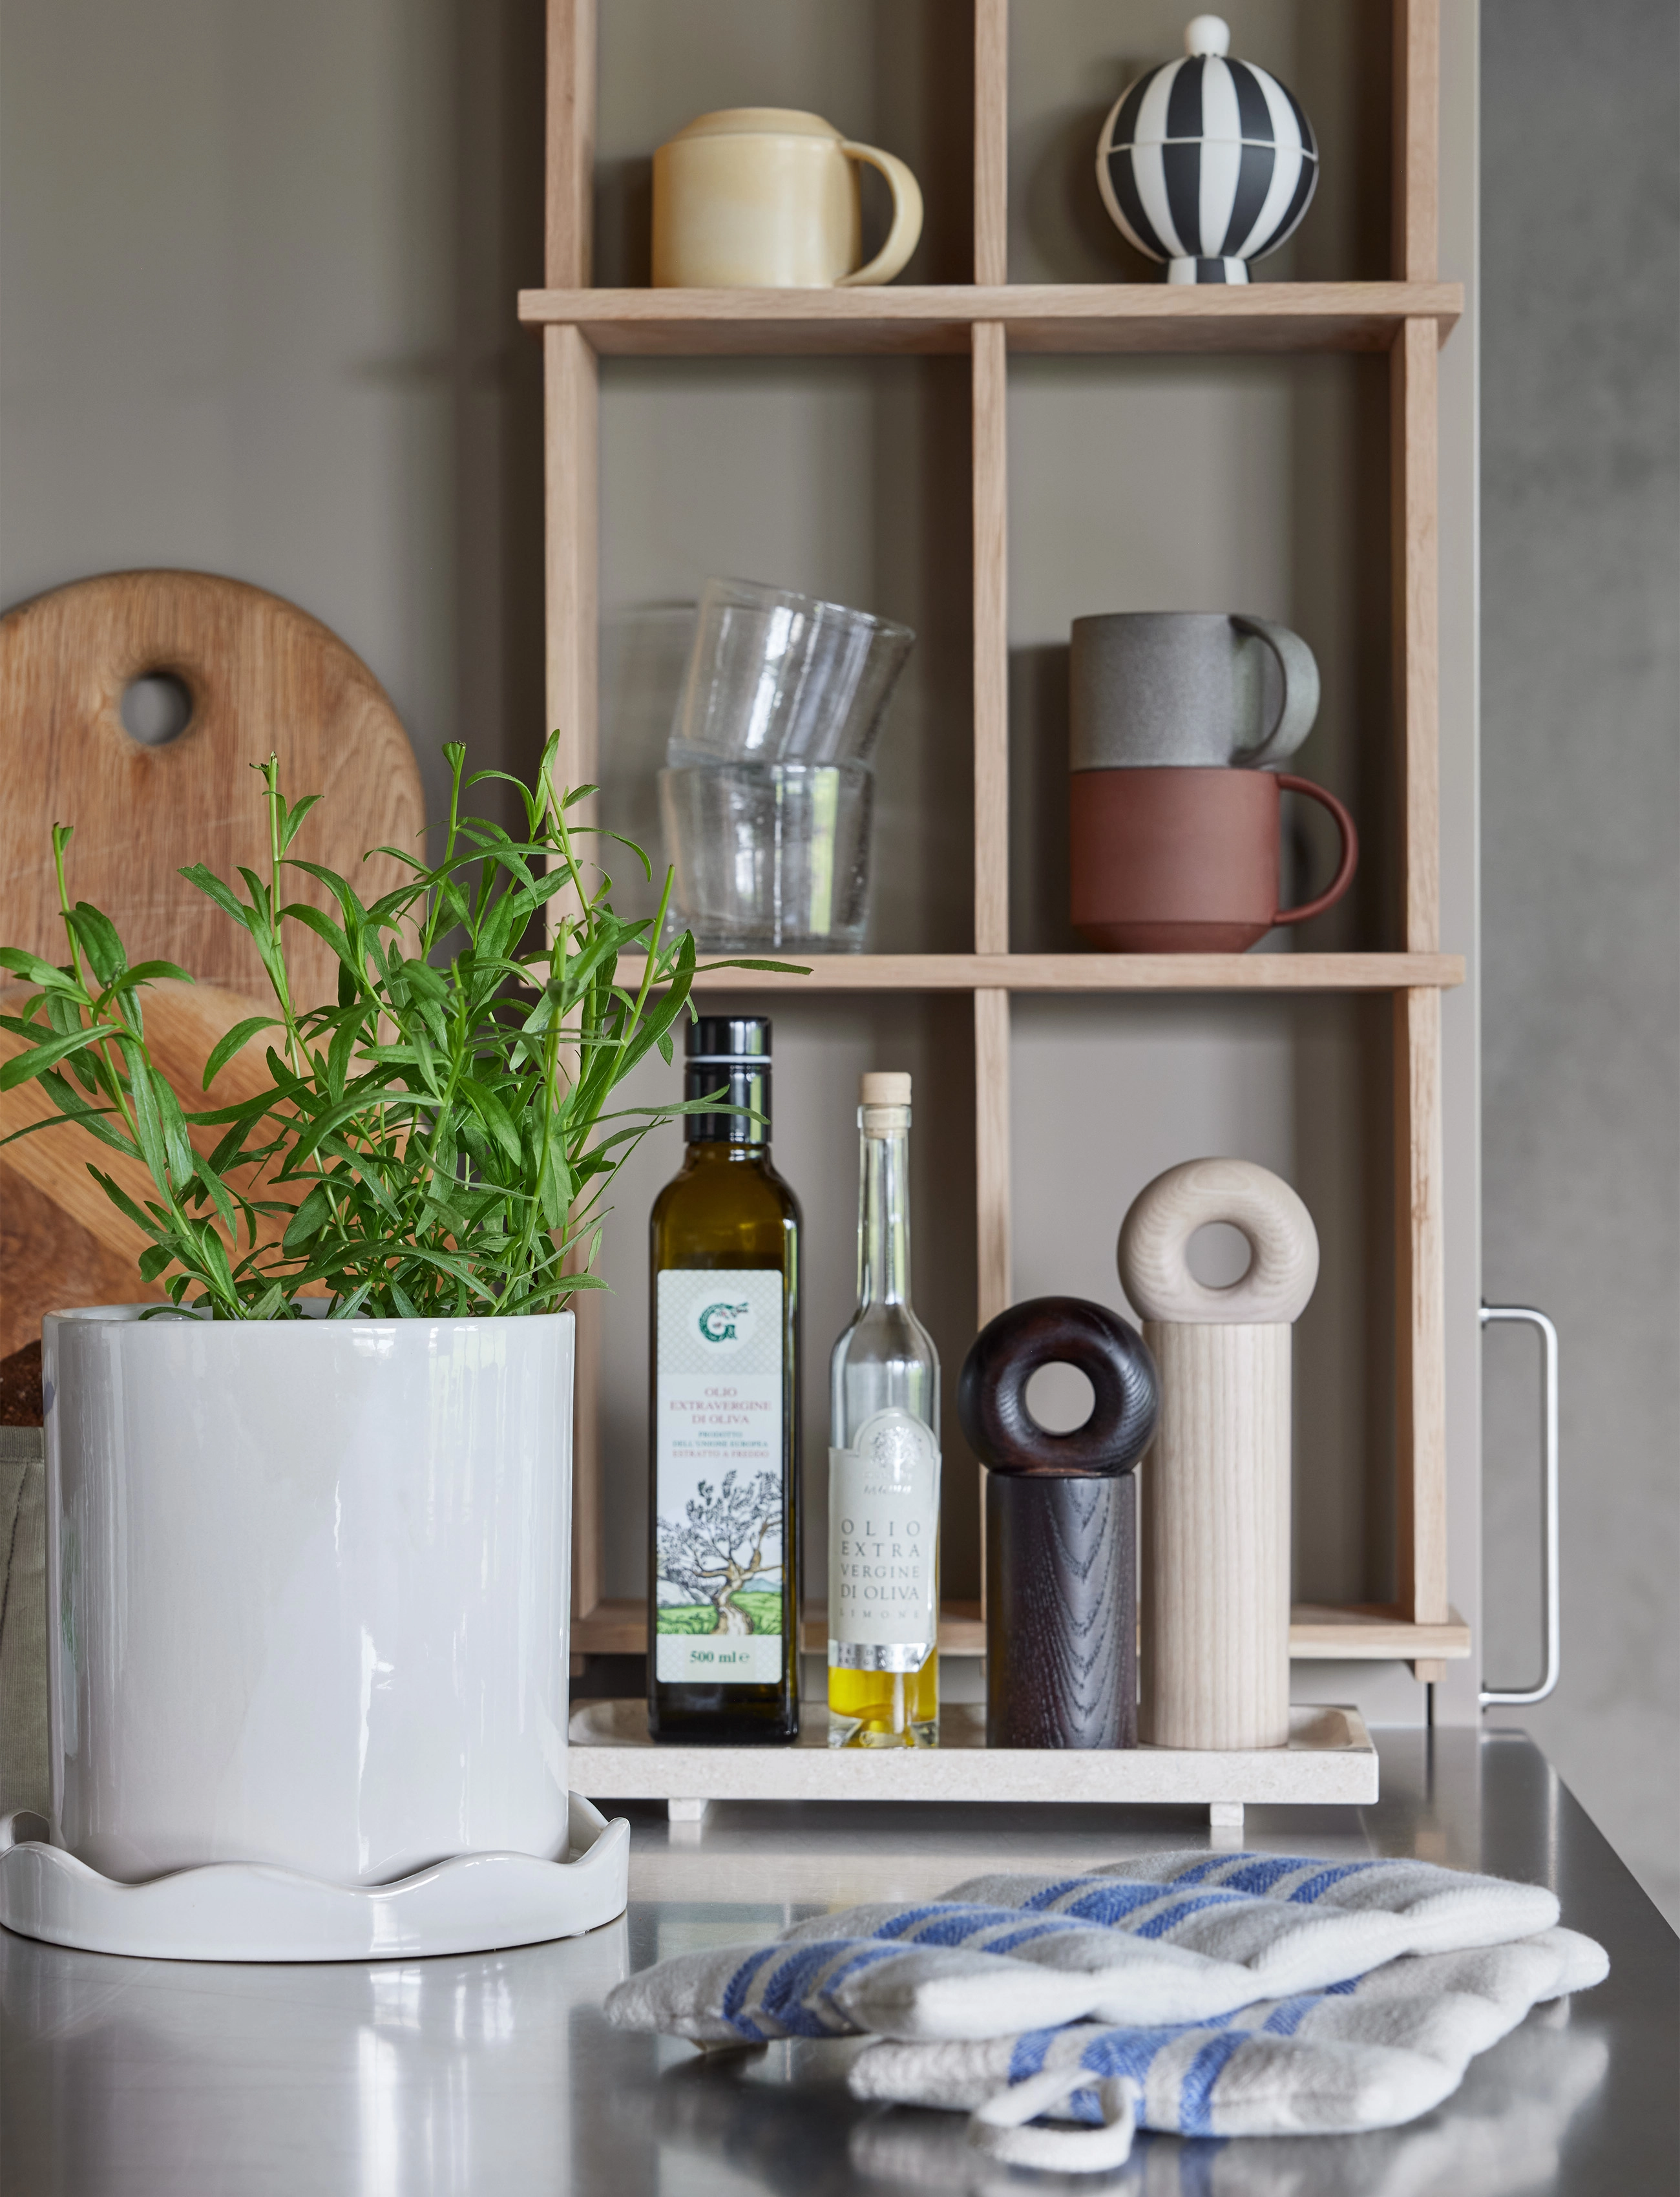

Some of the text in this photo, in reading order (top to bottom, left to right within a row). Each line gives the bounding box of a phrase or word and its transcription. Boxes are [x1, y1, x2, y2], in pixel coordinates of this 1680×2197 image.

[704, 1387, 737, 1397] OLIO
[670, 1400, 772, 1411] EXTRAVERGINE
[692, 1414, 750, 1424] DI OLIVA
[673, 1449, 770, 1458] ESTRATTO A FREDDO
[841, 1519, 921, 1537] OLIO
[841, 1540, 920, 1558] EXTRA
[841, 1562, 919, 1579] VERGINE
[841, 1583, 919, 1601] DI OLIVA
[839, 1607, 919, 1619] LIMONE
[690, 1650, 714, 1663] 500
[719, 1650, 736, 1663] ml
